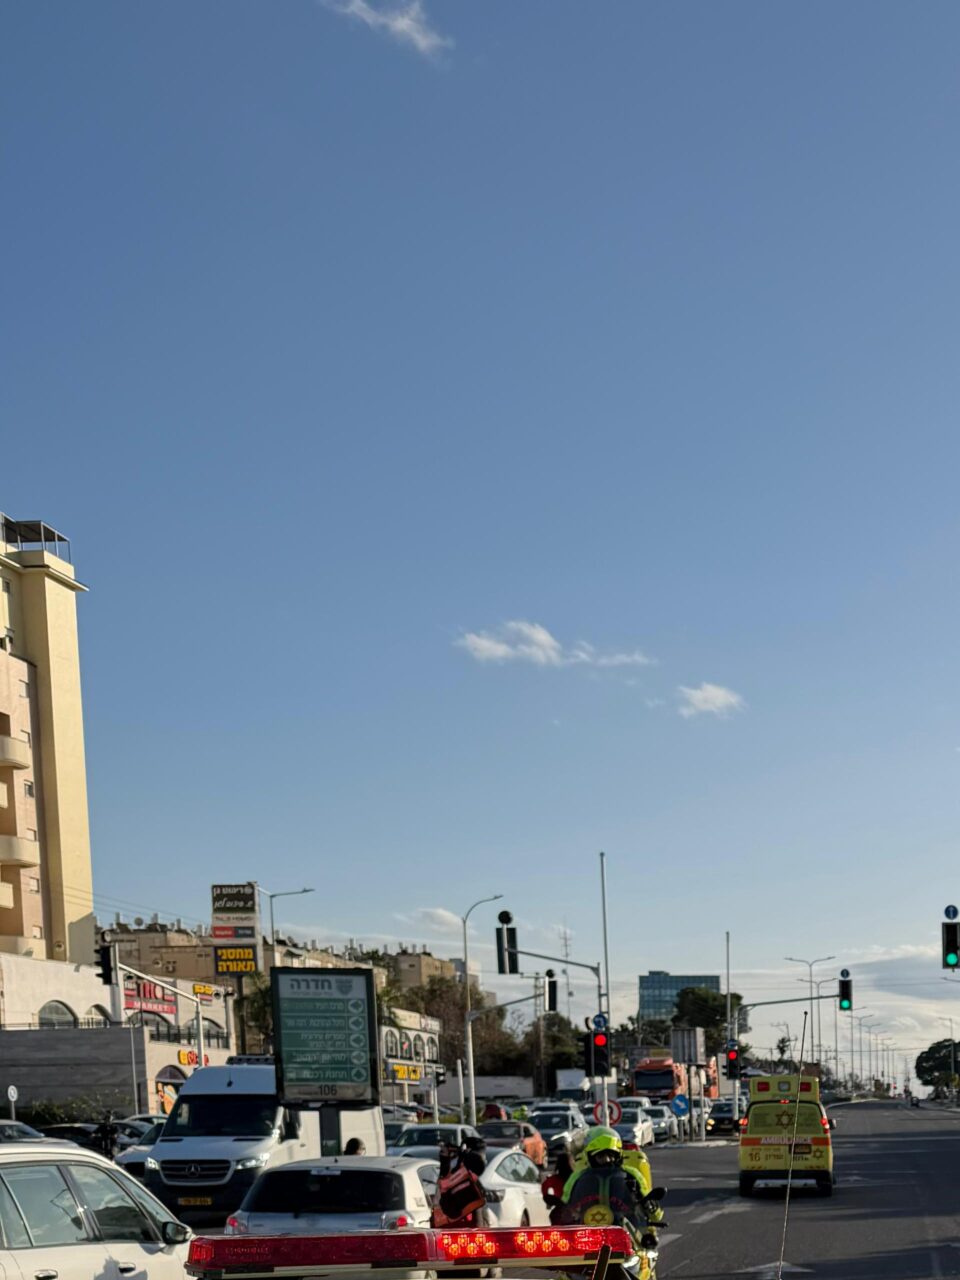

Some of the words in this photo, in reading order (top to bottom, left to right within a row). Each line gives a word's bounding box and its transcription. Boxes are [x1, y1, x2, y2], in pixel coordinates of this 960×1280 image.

[217, 948, 253, 960] מחסני
[217, 961, 255, 973] תאורה
[290, 979, 333, 990] חדרה
[319, 1085, 337, 1096] 106
